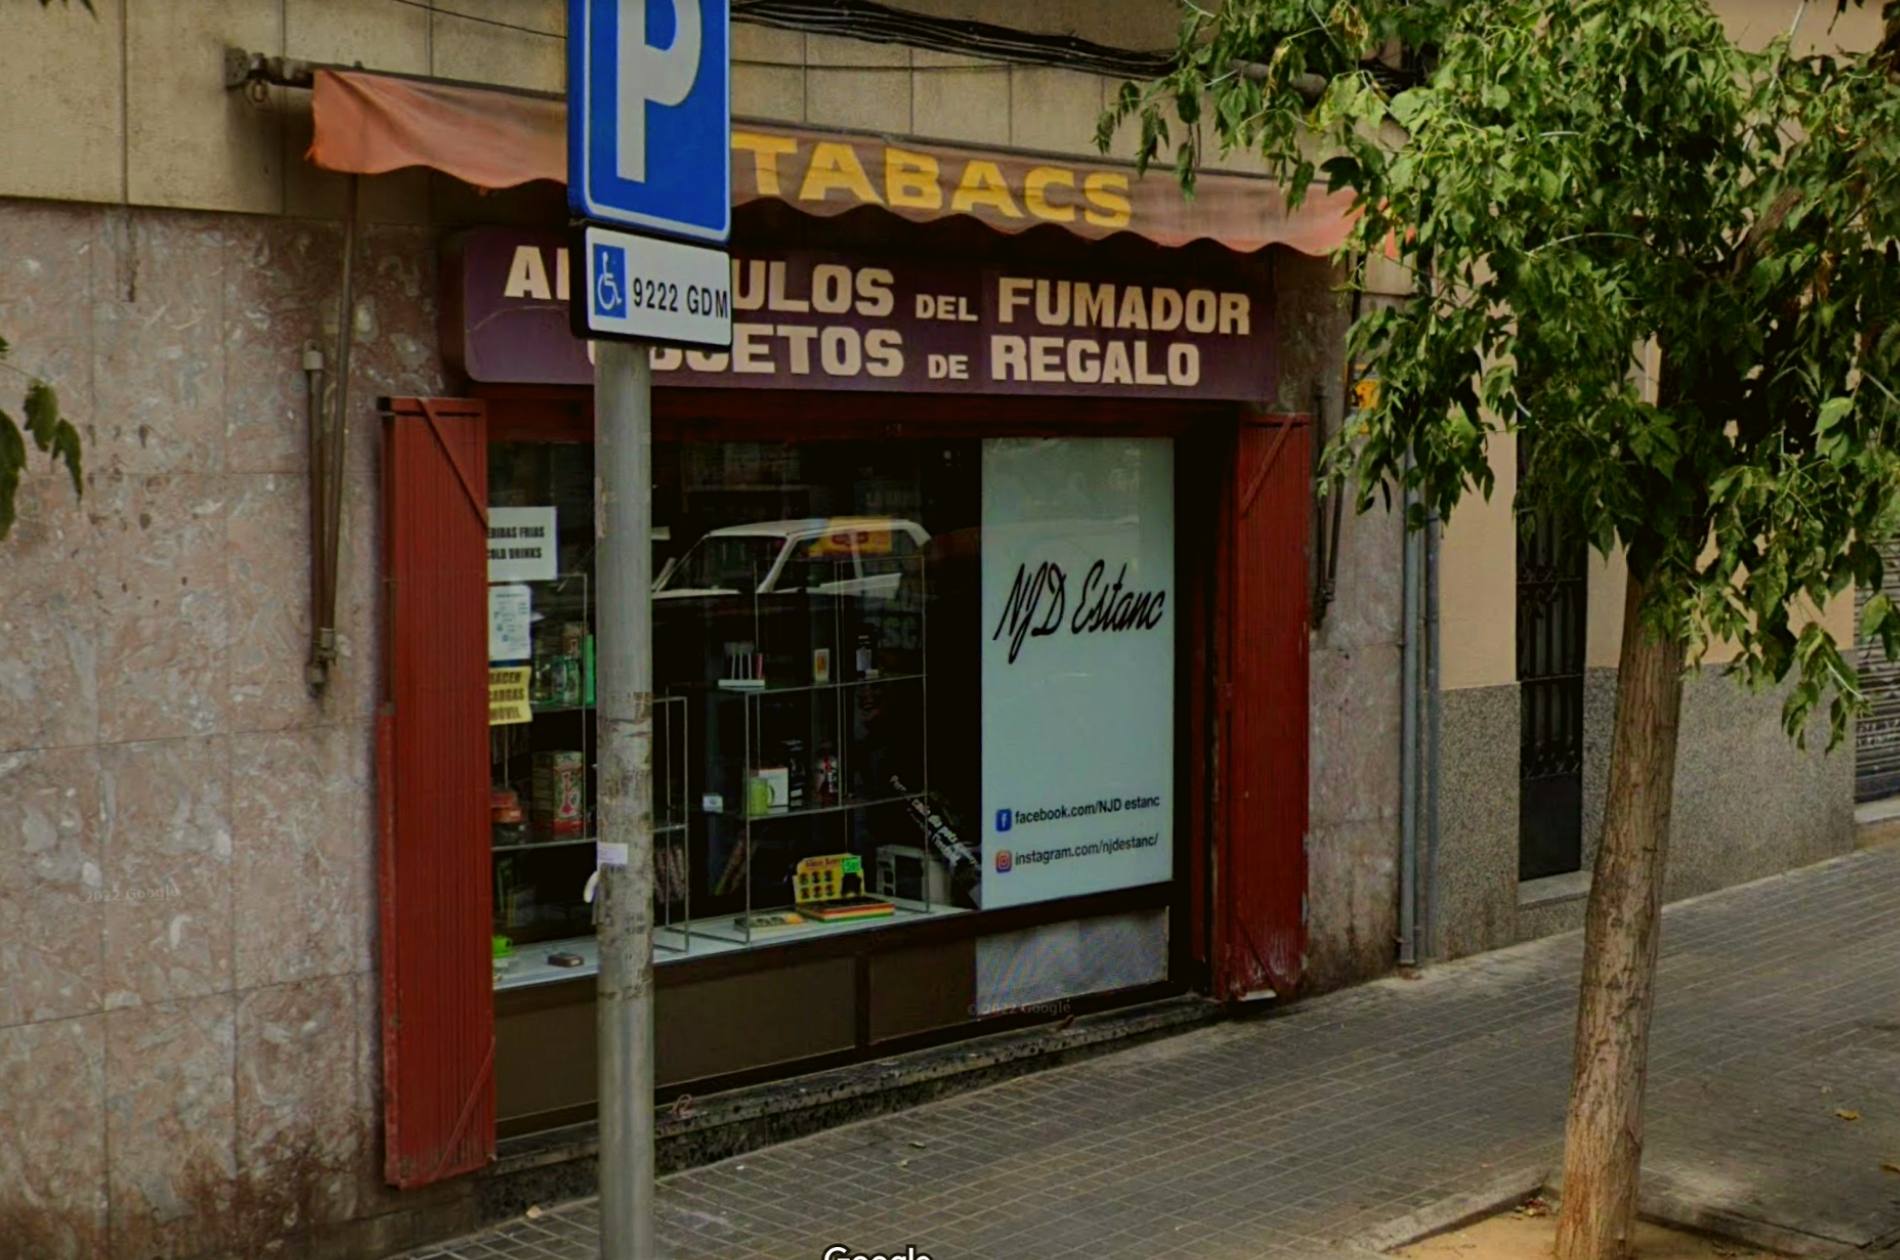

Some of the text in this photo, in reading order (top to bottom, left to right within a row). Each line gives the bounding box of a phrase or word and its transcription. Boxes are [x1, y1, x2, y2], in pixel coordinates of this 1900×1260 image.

[617, 0, 702, 184] P
[731, 129, 1132, 228] TABACS
[504, 244, 1251, 336] AULOS DEL FUMADOR
[632, 277, 729, 319] 9222 GDM
[927, 354, 970, 380] DE
[990, 335, 1201, 387] REGALO
[1070, 558, 1166, 635] Estanc
[1015, 799, 1122, 825] facebook.com/NJD
[1124, 795, 1161, 811] estanc
